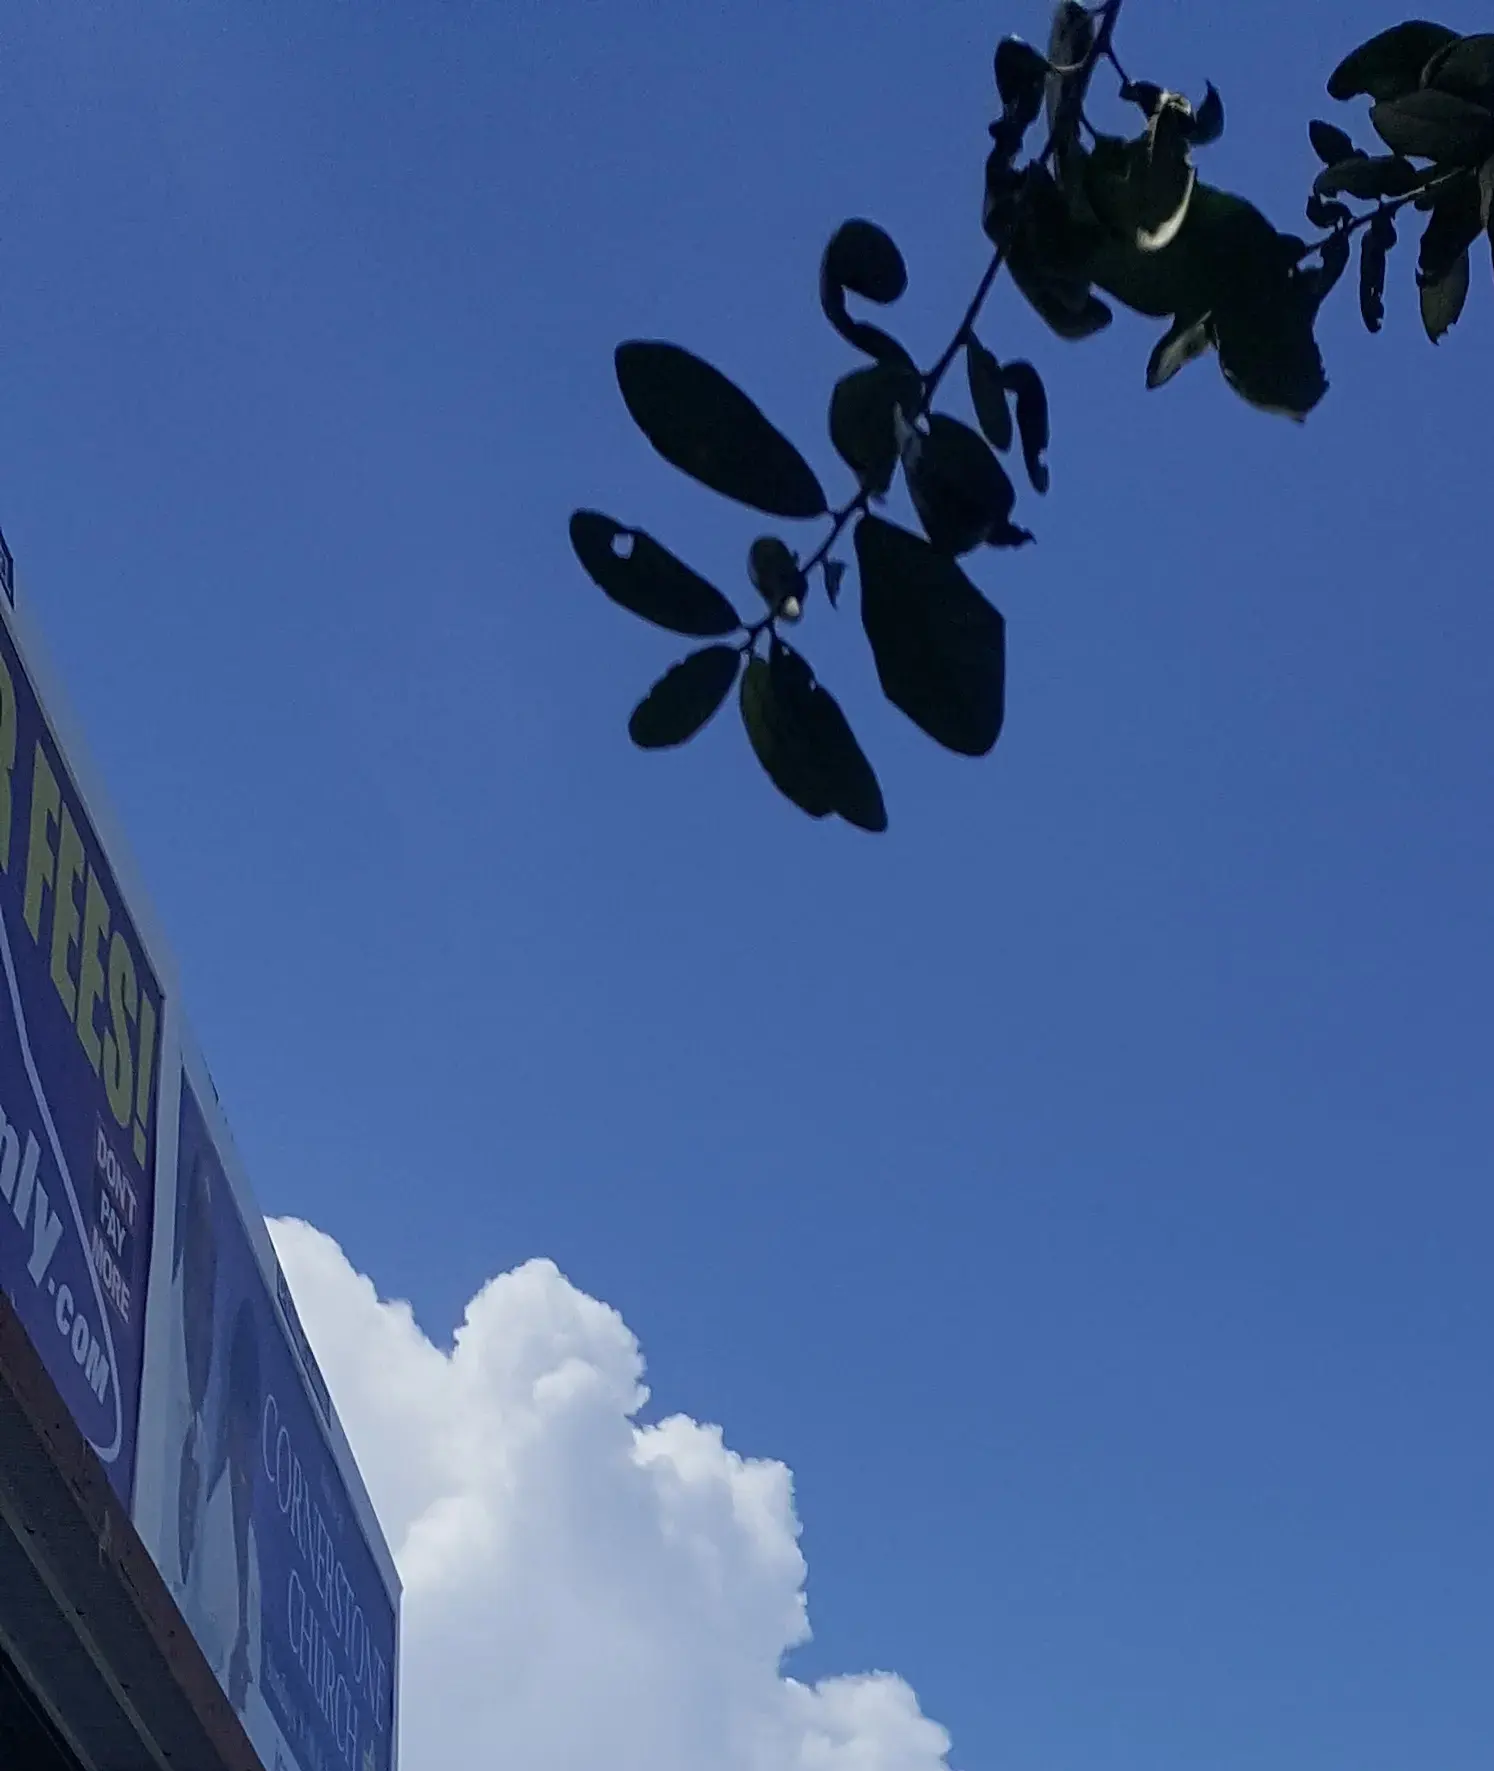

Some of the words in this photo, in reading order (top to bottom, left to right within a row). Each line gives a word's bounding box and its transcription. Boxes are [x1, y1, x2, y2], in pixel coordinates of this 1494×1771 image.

[24, 739, 156, 1170] FEES!
[92, 1226, 131, 1324] MORE
[100, 1189, 127, 1257] PAY
[263, 1394, 386, 1732] CORNERSTONE
